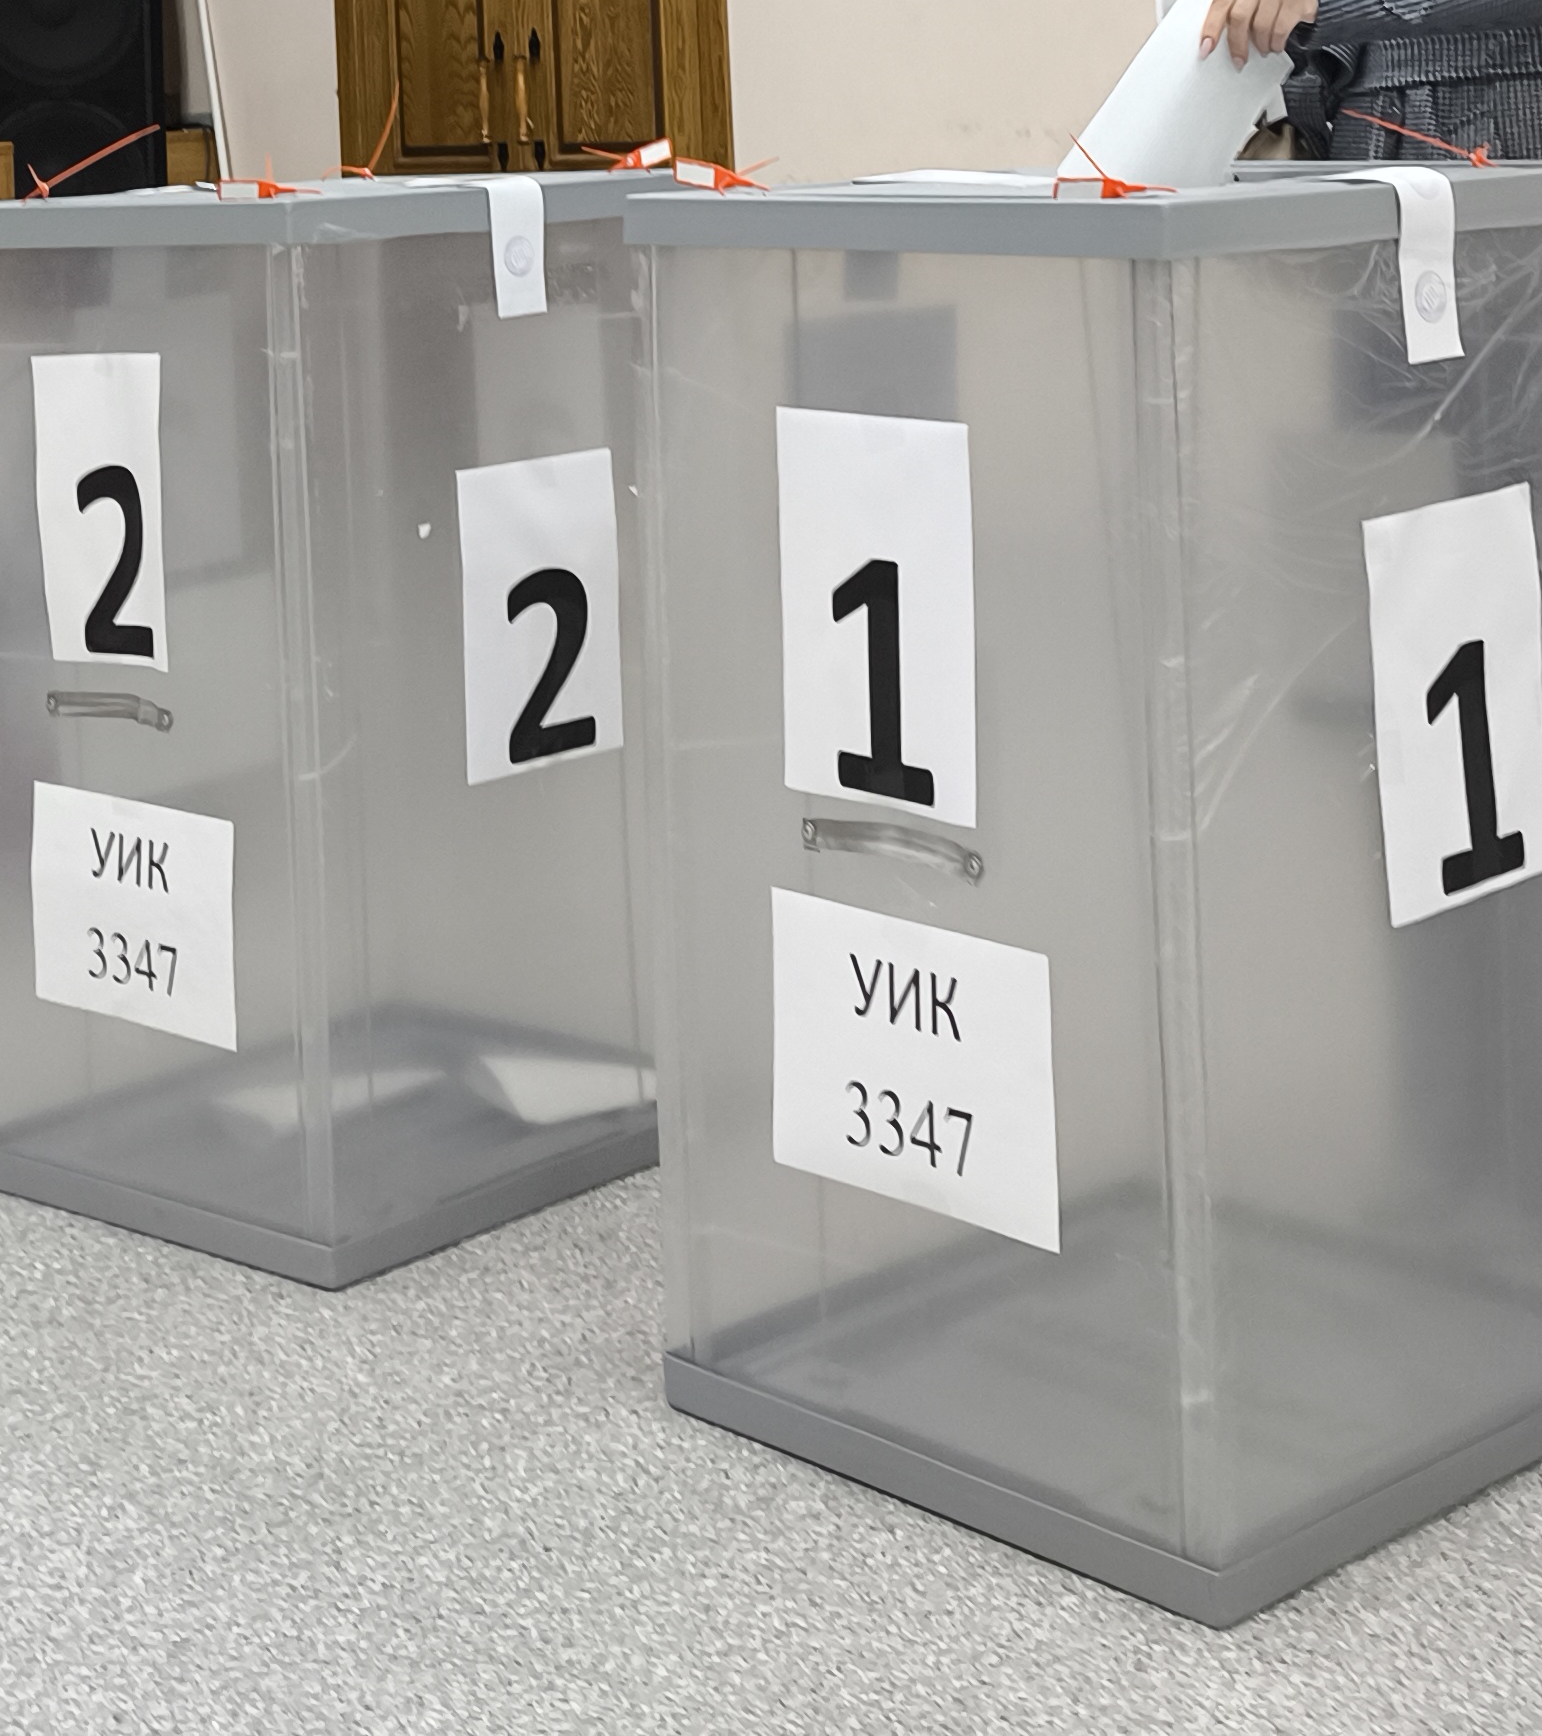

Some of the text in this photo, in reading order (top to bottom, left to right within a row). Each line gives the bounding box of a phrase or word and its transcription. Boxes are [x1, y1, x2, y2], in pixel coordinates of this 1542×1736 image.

[76, 465, 154, 659] 2
[507, 568, 597, 764] 2
[832, 559, 935, 807] 1
[1426, 639, 1524, 895] 1
[90, 827, 169, 893] УИК
[88, 927, 177, 996] 3347
[849, 953, 961, 1042] УИК
[845, 1080, 973, 1177] 3347
